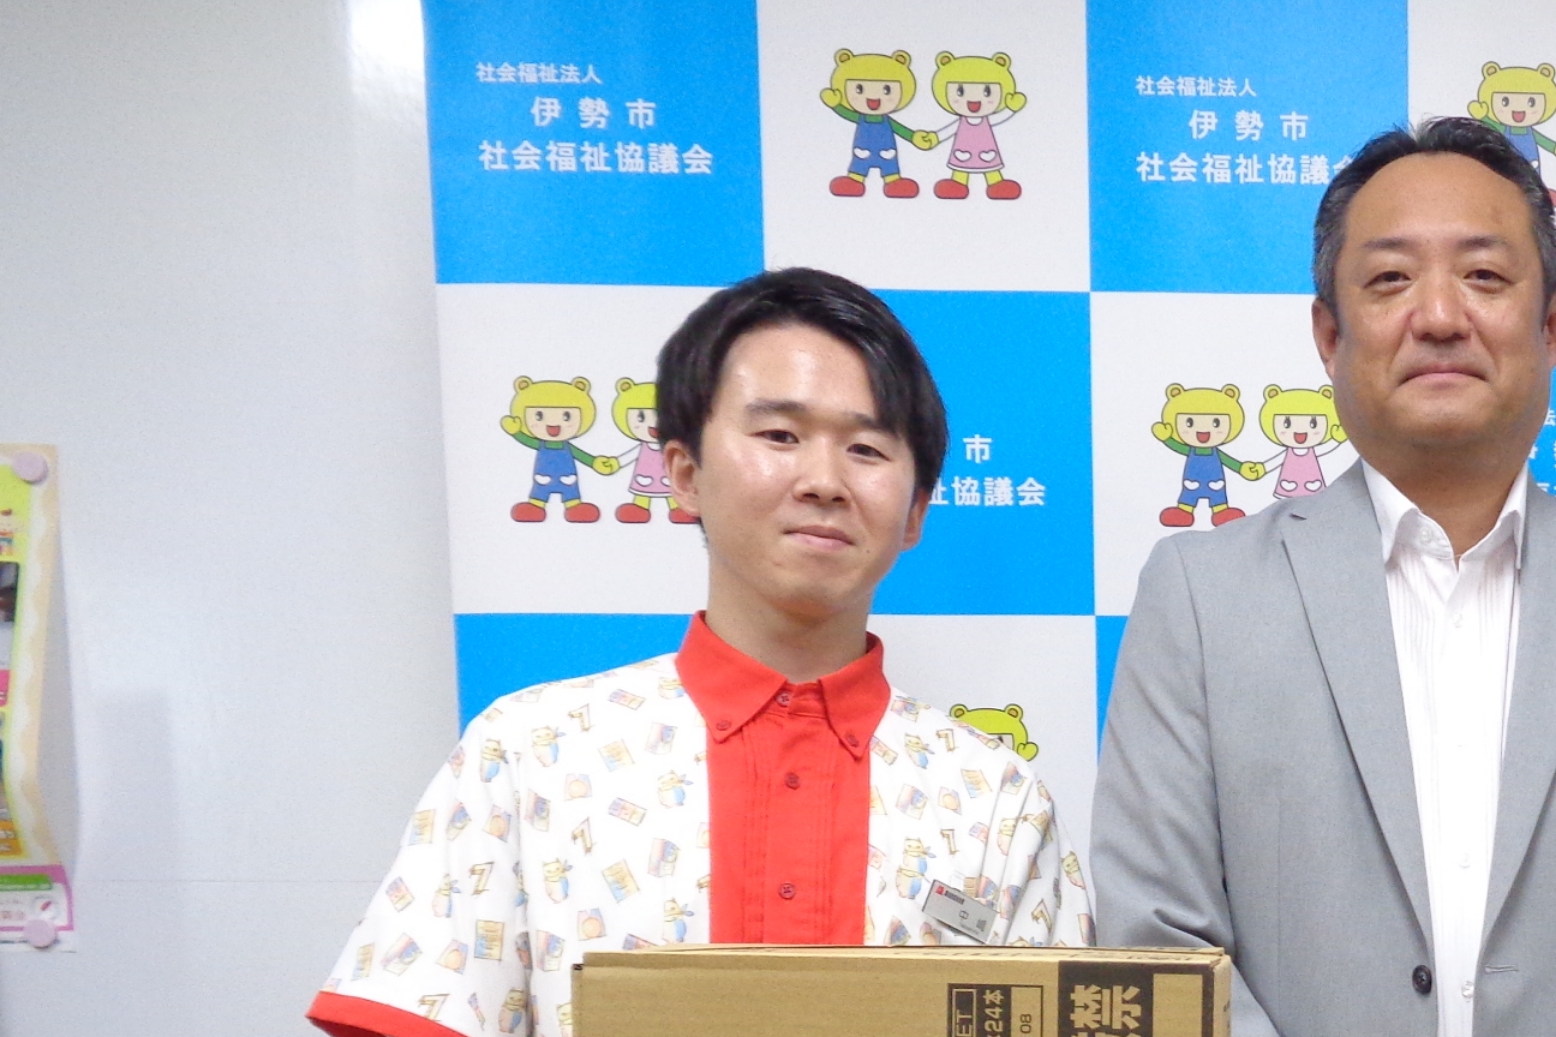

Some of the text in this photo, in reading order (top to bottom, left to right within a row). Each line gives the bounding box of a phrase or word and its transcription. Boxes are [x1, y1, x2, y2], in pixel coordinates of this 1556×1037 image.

[476, 62, 602, 84] 社会福祉法人
[1135, 75, 1257, 97] 社会福祉法人
[530, 96, 656, 129] 伊勢市
[1188, 109, 1309, 141] 伊勢市
[478, 140, 713, 175] 社会福祉協議会
[962, 434, 993, 464] 市
